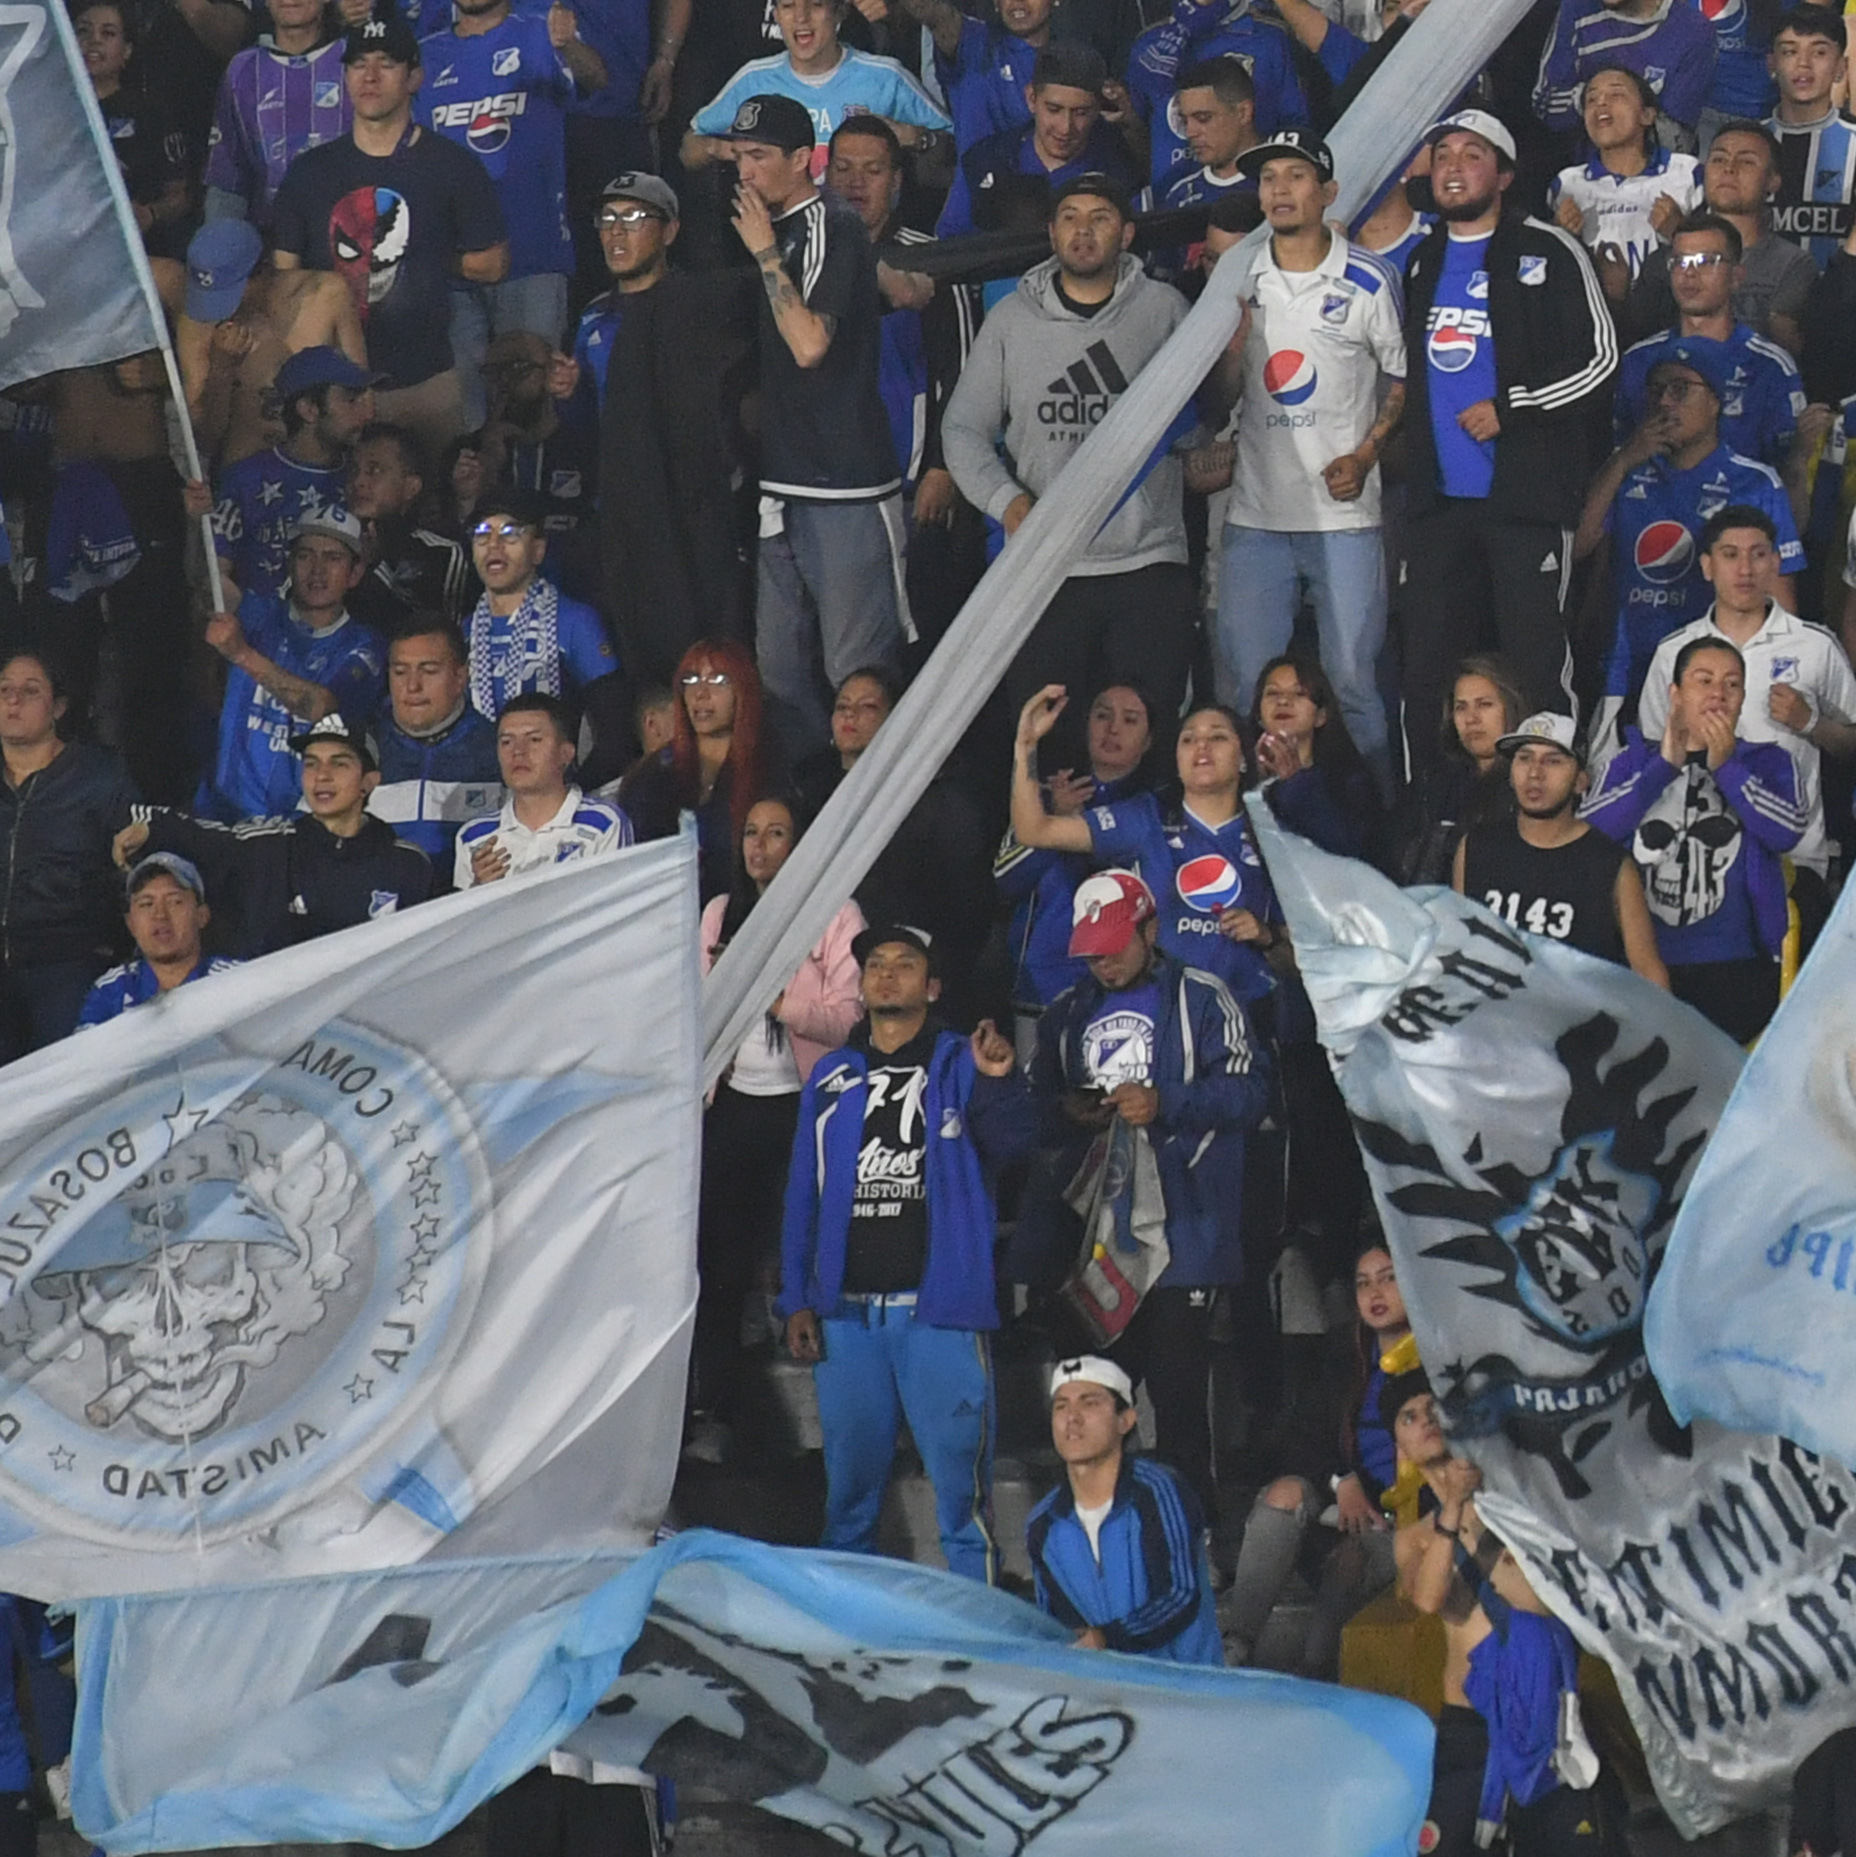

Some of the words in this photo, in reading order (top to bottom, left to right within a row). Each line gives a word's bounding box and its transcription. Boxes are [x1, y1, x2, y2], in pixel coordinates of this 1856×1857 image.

[431, 91, 528, 132] PEPSI
[1771, 206, 1848, 236] MCEL
[1036, 393, 1109, 427] adid
[1265, 413, 1317, 431] pepsi
[1628, 587, 1686, 608] pepsi
[1484, 888, 1576, 939] 3143
